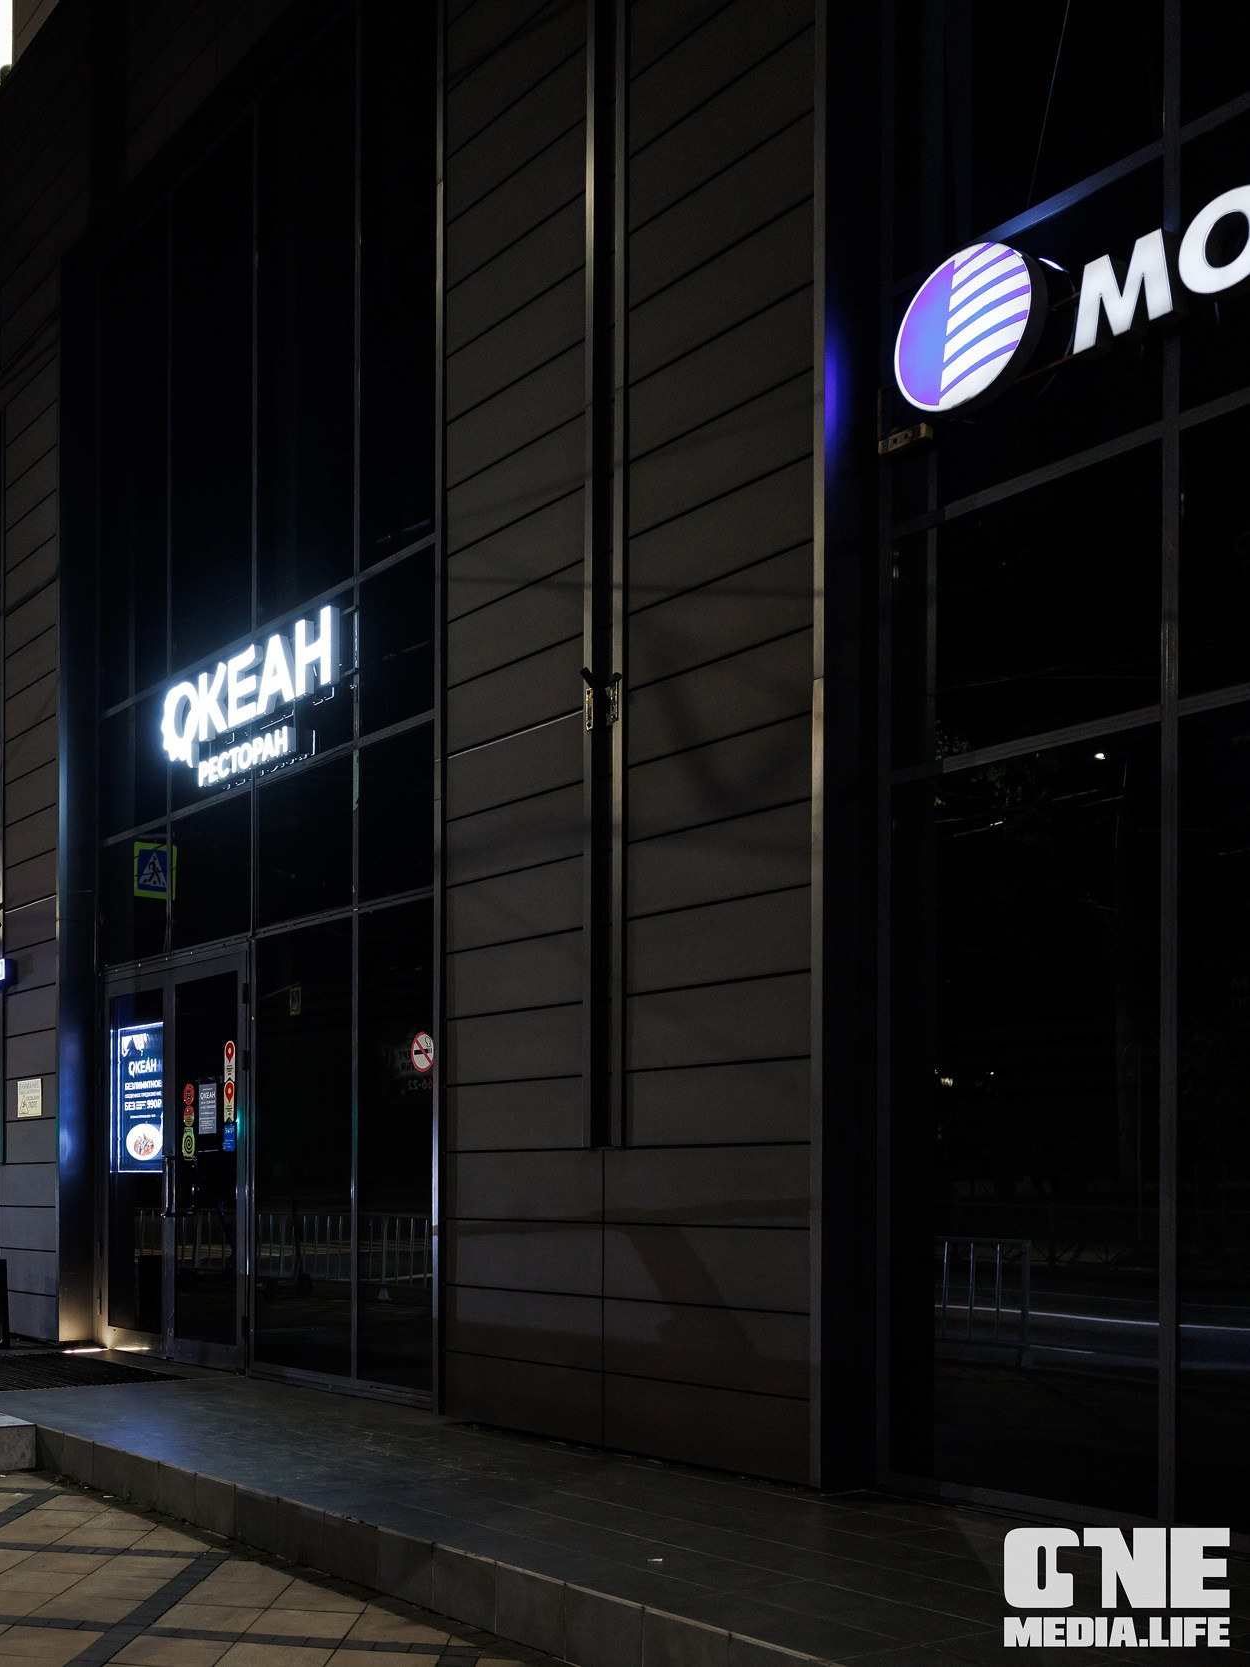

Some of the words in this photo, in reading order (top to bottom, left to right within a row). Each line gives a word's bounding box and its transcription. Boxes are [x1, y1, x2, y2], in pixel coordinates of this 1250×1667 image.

[161, 605, 336, 769] ОКЕАН
[198, 725, 291, 787] РЕСТОРАН
[128, 1057, 157, 1078] ОКЕАН
